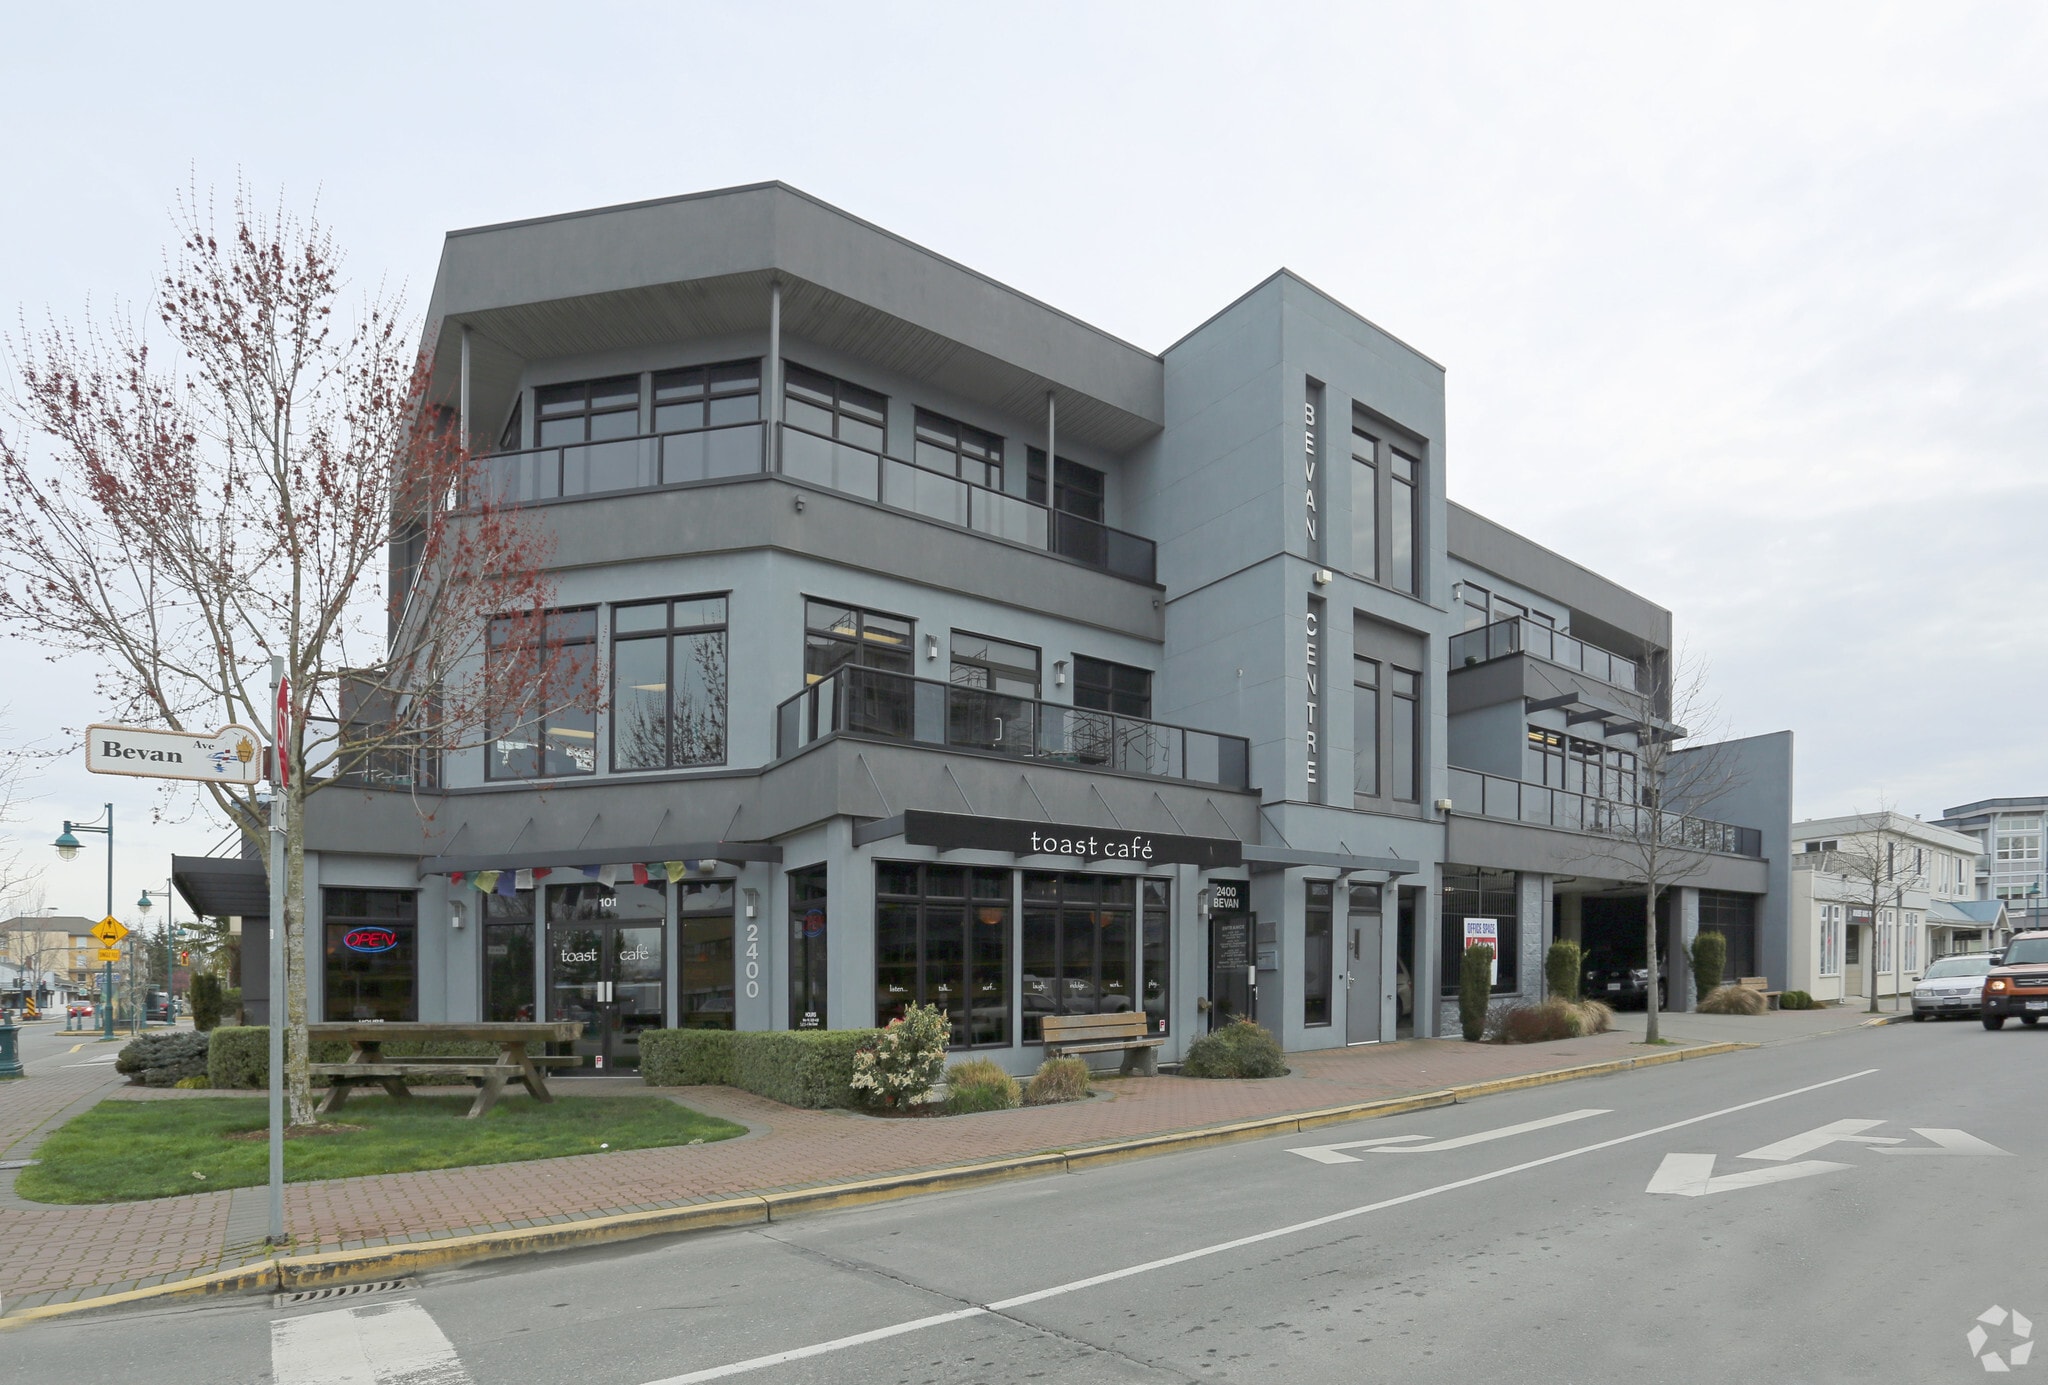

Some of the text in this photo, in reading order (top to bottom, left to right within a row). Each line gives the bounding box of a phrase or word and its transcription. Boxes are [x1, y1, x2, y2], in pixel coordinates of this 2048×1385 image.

[1305, 402, 1316, 541] BEVAN
[1306, 612, 1317, 783] CENTRE
[102, 740, 215, 764] Bevan Ave
[1031, 831, 1153, 859] toast café
[1216, 886, 1237, 897] 2400
[599, 898, 617, 907] 101
[1213, 898, 1239, 909] BEVAN
[1467, 922, 1495, 934] OFFICE SPACE
[345, 932, 397, 947] OPEN
[561, 944, 649, 962] toast café
[745, 924, 759, 998] 2400
